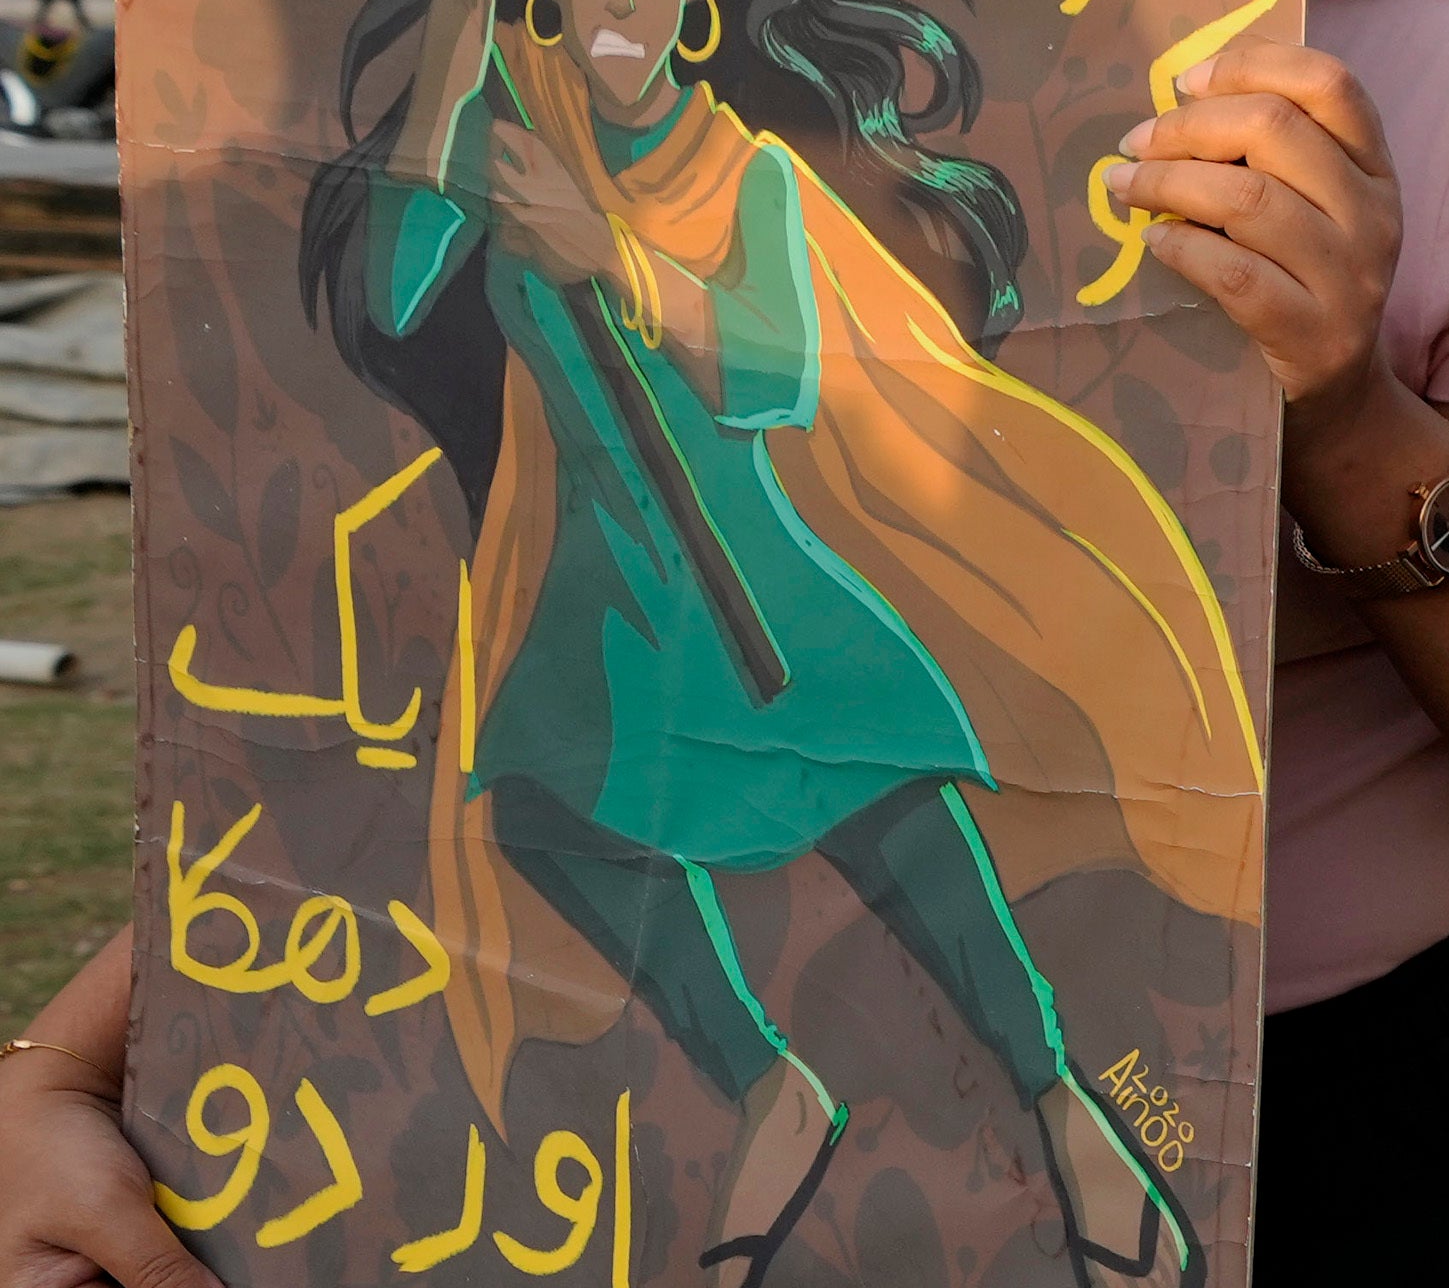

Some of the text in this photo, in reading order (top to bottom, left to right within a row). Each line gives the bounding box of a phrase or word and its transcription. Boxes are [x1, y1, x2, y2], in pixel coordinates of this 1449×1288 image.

[168, 447, 475, 773] ایک
[152, 1063, 363, 1248] دو
[1132, 1064, 1195, 1143] 2020
